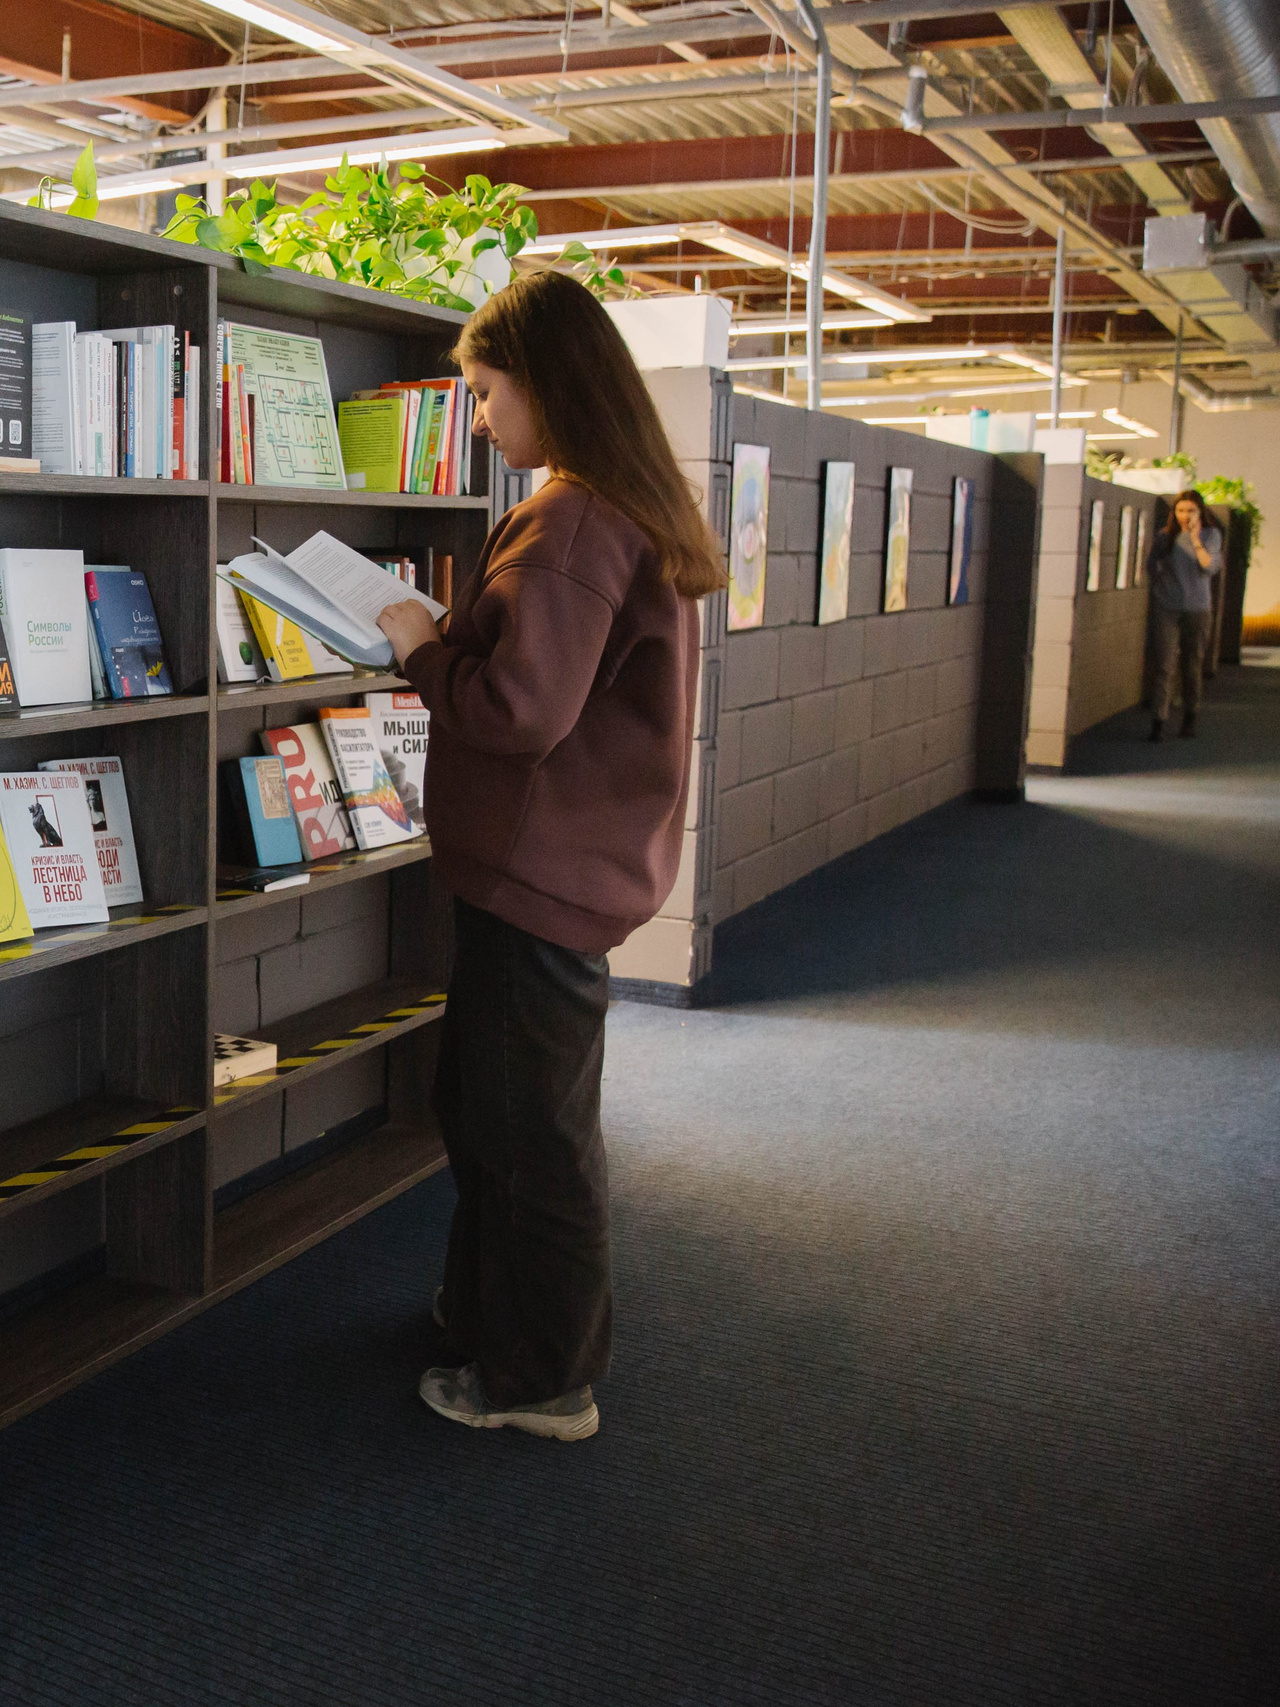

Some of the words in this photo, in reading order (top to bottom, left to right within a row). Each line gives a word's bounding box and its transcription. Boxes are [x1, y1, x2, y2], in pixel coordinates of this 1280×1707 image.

[28, 634, 64, 646] России
[402, 739, 428, 754] СИЛ
[96, 761, 120, 774] ЩЕГЛОВ
[3, 778, 13, 790] М.
[14, 778, 41, 790] ХАЗИН,
[42, 778, 50, 790] С.
[50, 777, 80, 790] ЩЕГЛОВ
[267, 727, 341, 859] PRO
[320, 780, 342, 805] ИД
[31, 856, 56, 866] КРИЗИС
[60, 854, 84, 865] ВЛАСТЬ
[96, 848, 120, 868] ЮДИ
[32, 866, 88, 884] ЛЕСТНИЦА
[102, 870, 122, 886] АСТИ
[44, 886, 52, 903] В
[53, 884, 82, 903] НЕБО
